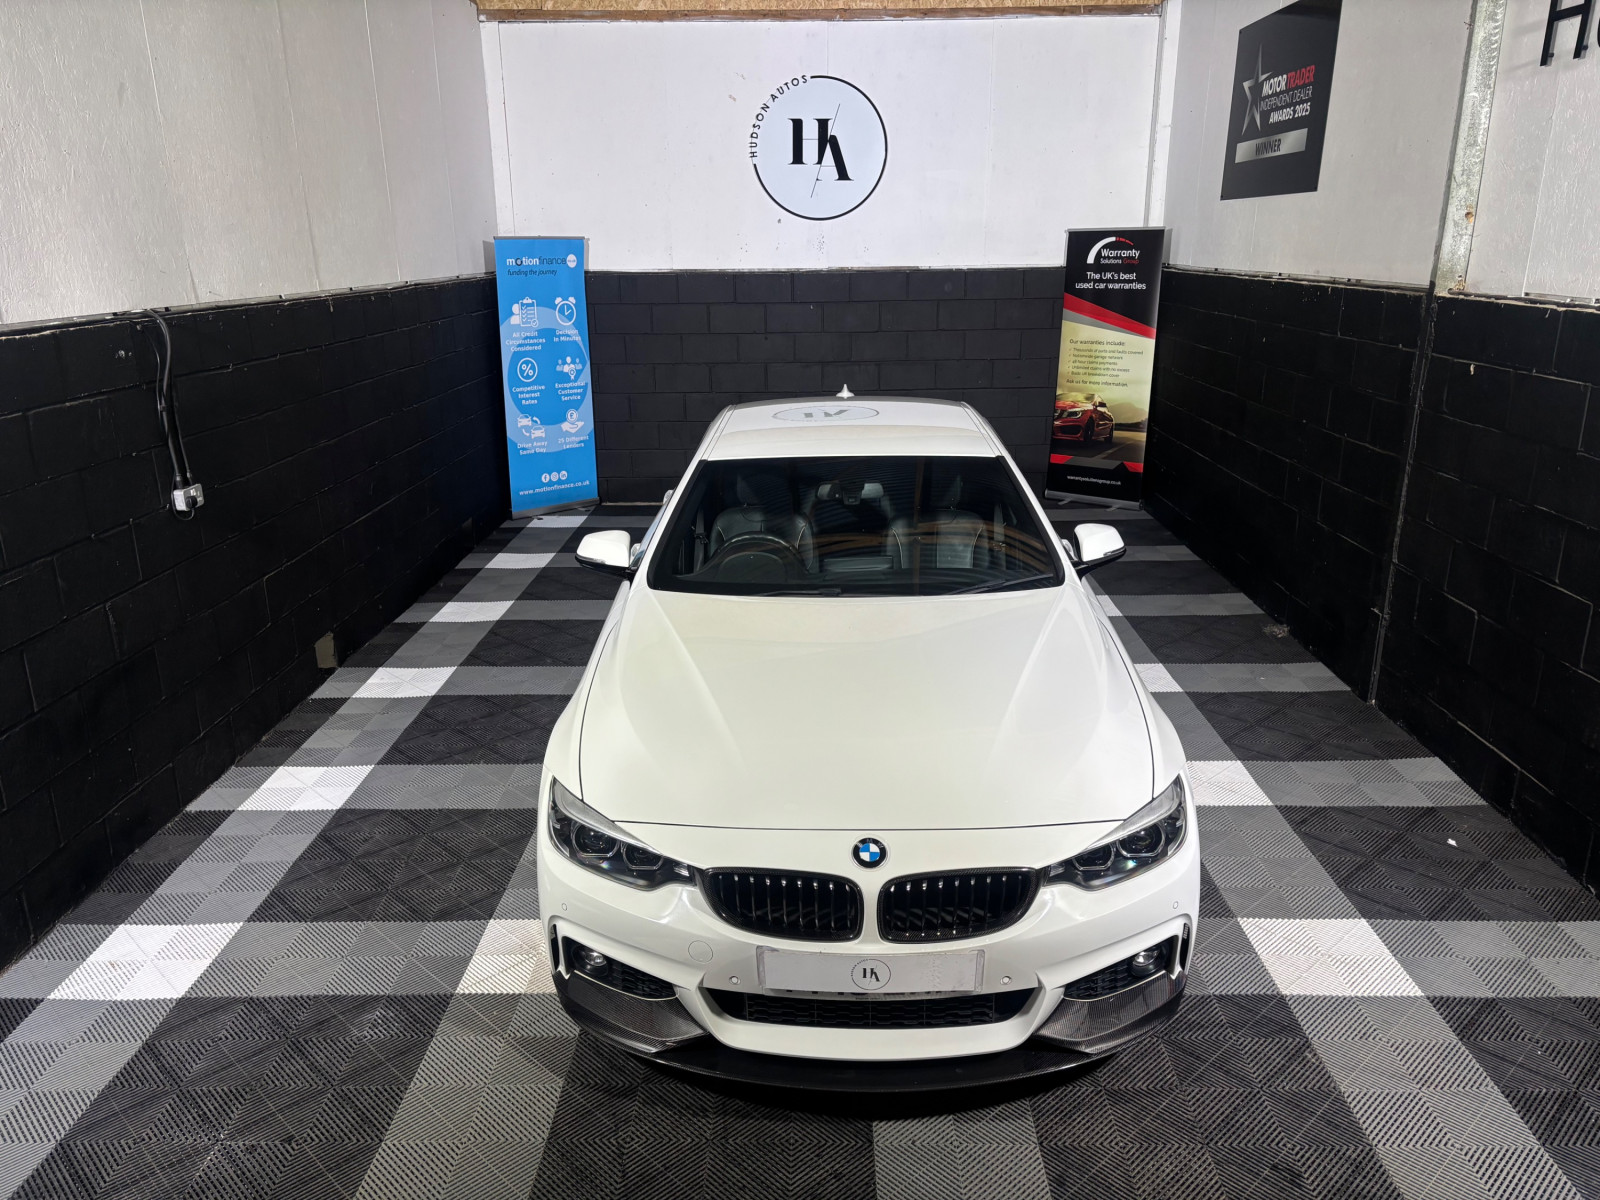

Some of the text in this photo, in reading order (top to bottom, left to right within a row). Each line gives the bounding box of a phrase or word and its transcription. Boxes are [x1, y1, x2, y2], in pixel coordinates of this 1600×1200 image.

[1260, 86, 1313, 111] INDEPENDENT DEALER
[749, 75, 807, 158] HUDSON AUTOS
[1269, 102, 1311, 124] AWARDS 2025
[1255, 138, 1282, 156] WINNER
[1101, 248, 1140, 259] Warranty
[507, 269, 529, 277] funding
[537, 269, 557, 277] journey
[1086, 271, 1136, 280] The UK's best
[1075, 281, 1093, 289] used
[1107, 282, 1146, 290] warranties
[505, 337, 546, 345] Circumstances
[510, 344, 542, 352] Considered
[555, 381, 586, 389] Exceptional
[519, 480, 590, 495] www.motionfinance.co.uk
